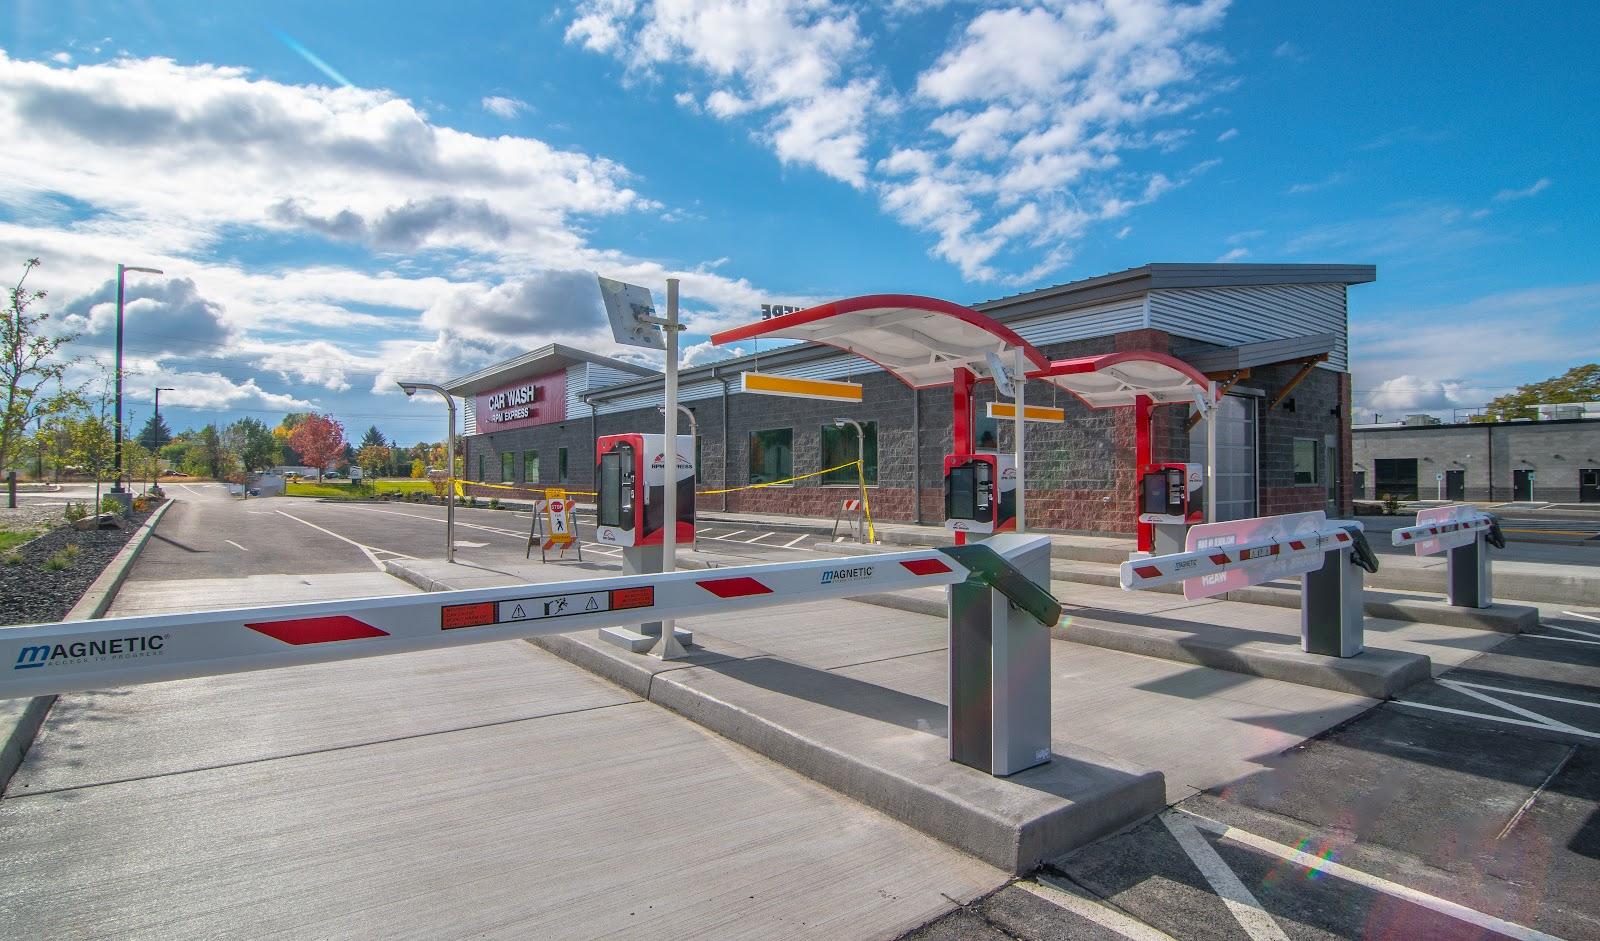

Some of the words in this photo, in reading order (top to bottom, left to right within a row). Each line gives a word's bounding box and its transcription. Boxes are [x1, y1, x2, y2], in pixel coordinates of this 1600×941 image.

[488, 393, 505, 410] CAR
[507, 384, 535, 407] WASH
[504, 407, 529, 421] EXPRESS
